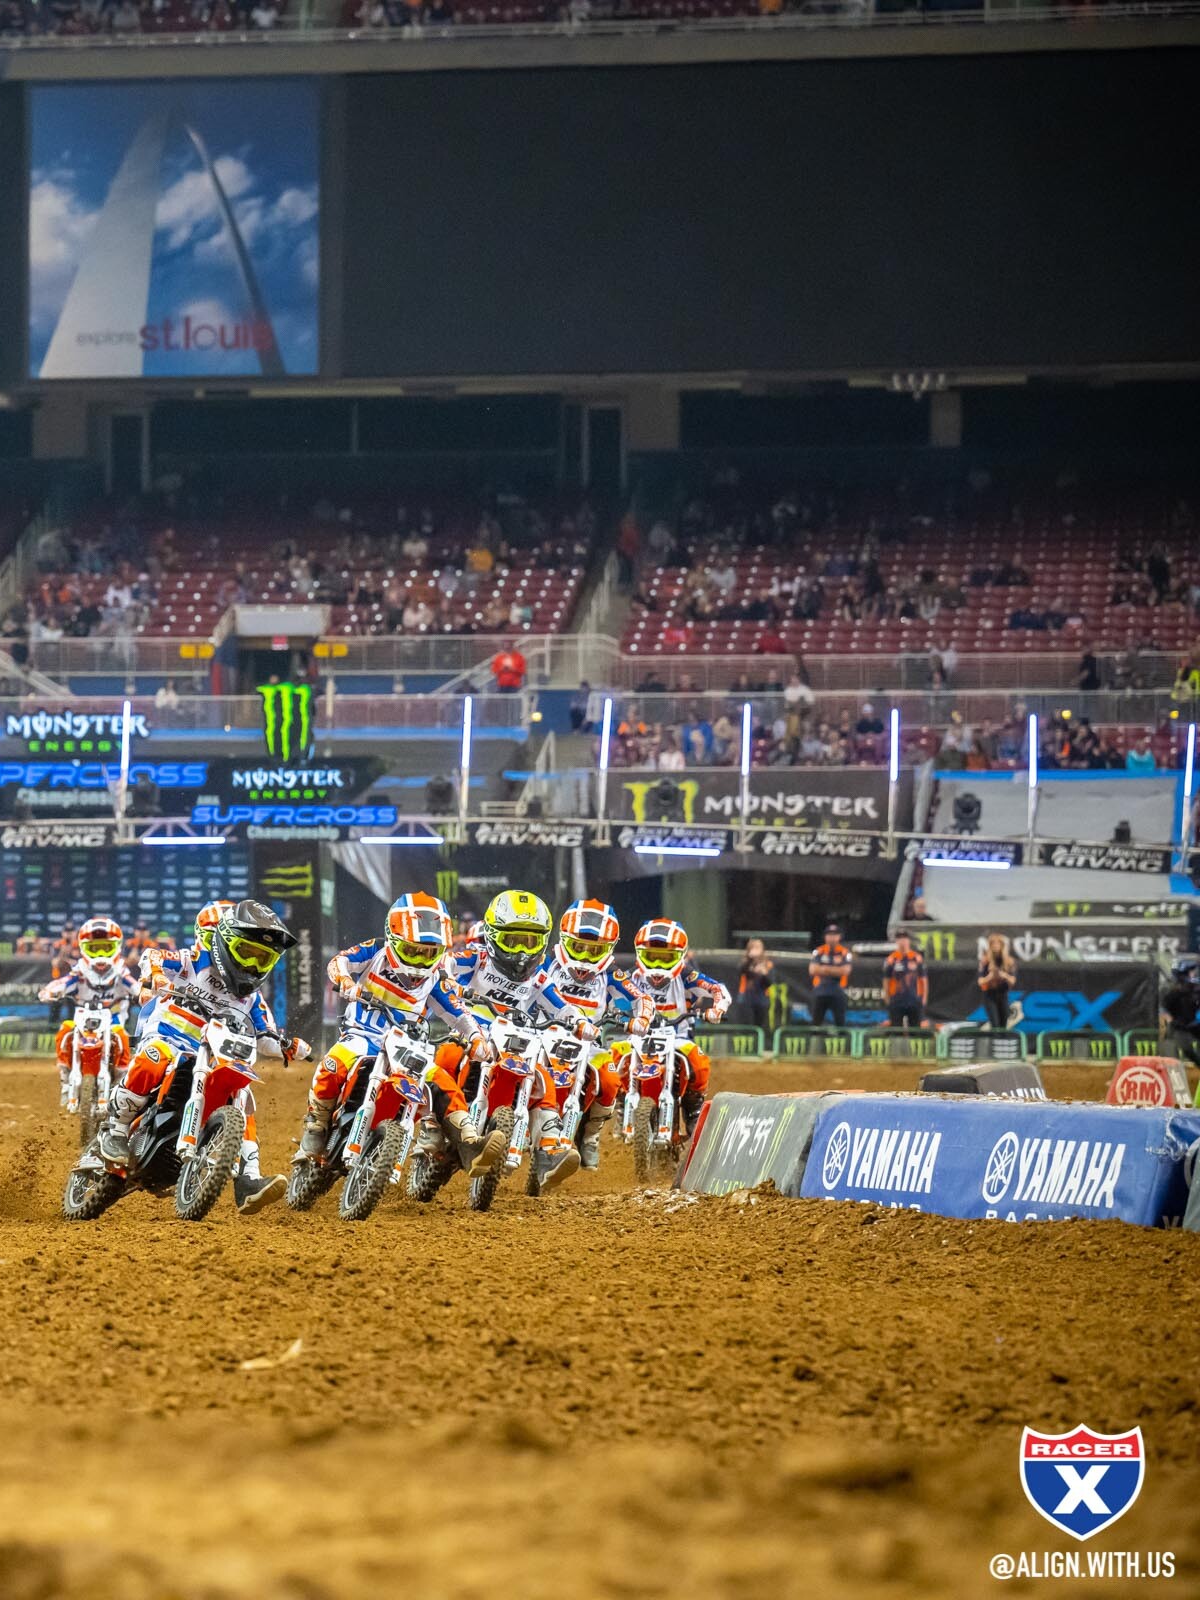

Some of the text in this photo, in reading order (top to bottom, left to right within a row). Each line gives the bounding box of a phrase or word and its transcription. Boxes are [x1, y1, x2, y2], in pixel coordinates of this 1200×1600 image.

[6, 711, 149, 739] MONSTER
[28, 740, 122, 752] ENERG
[232, 767, 344, 789] MONSTER
[250, 789, 327, 800] ENERGY
[704, 792, 879, 818] MONSTER
[192, 804, 398, 826] SUPERCROSS
[484, 972, 519, 991] TROY LEE
[560, 985, 592, 998] KTM
[485, 989, 521, 1008] KTM
[191, 1107, 200, 1136] DUNLOP
[847, 1128, 942, 1193] YAMAHA
[1013, 1138, 1126, 1208] YAMAHA
